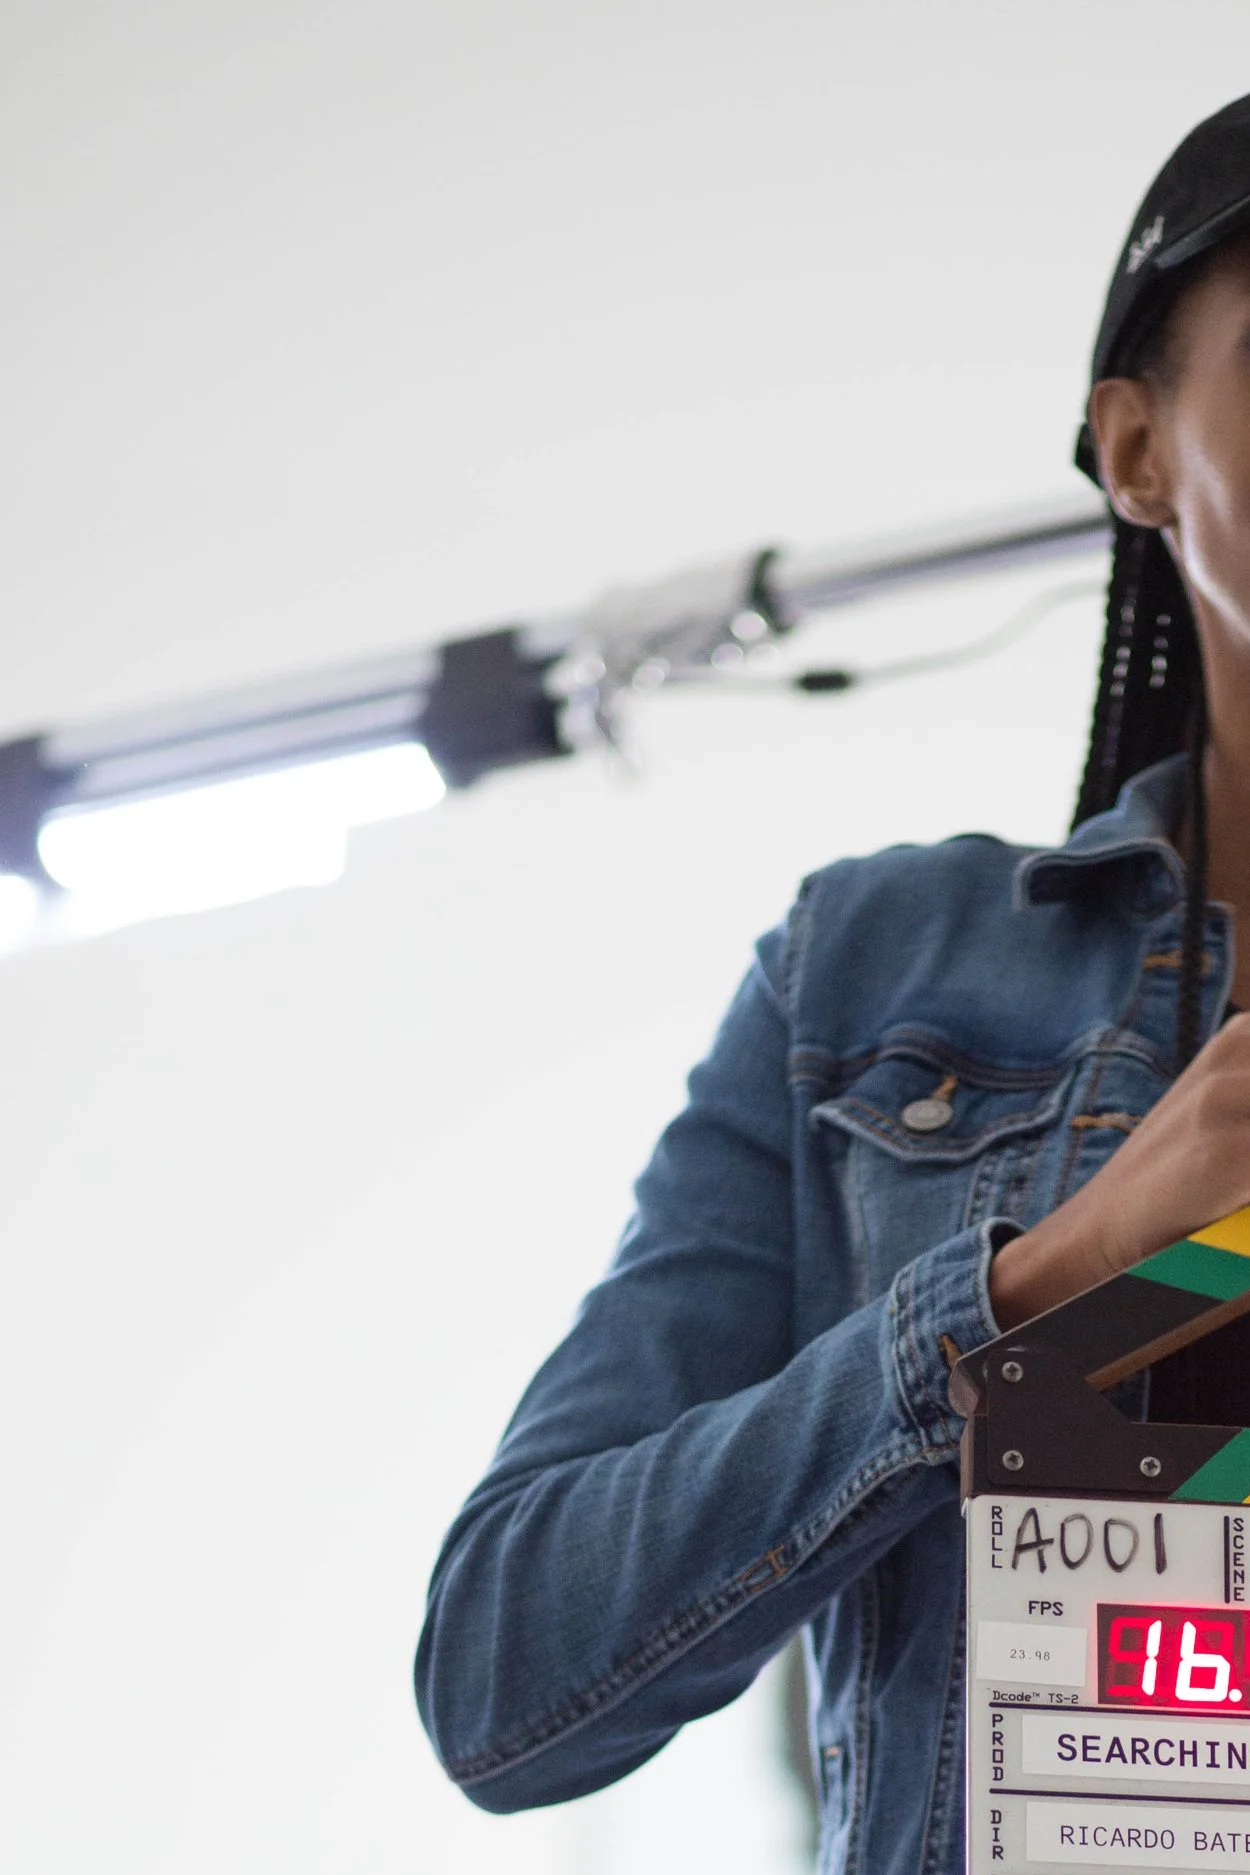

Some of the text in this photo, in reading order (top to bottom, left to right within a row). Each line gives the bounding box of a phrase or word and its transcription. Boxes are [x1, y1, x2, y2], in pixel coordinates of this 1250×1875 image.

[990, 1505, 1003, 1569] ROLL
[1232, 1517, 1245, 1603] SCENE
[1028, 1600, 1064, 1616] FPS
[1009, 1648, 1051, 1662] 23.98
[1048, 1693, 1079, 1704] TS-2
[990, 1713, 1004, 1781] PROD
[990, 1809, 1004, 1860] DIR
[1060, 1825, 1175, 1850] RICARDO
